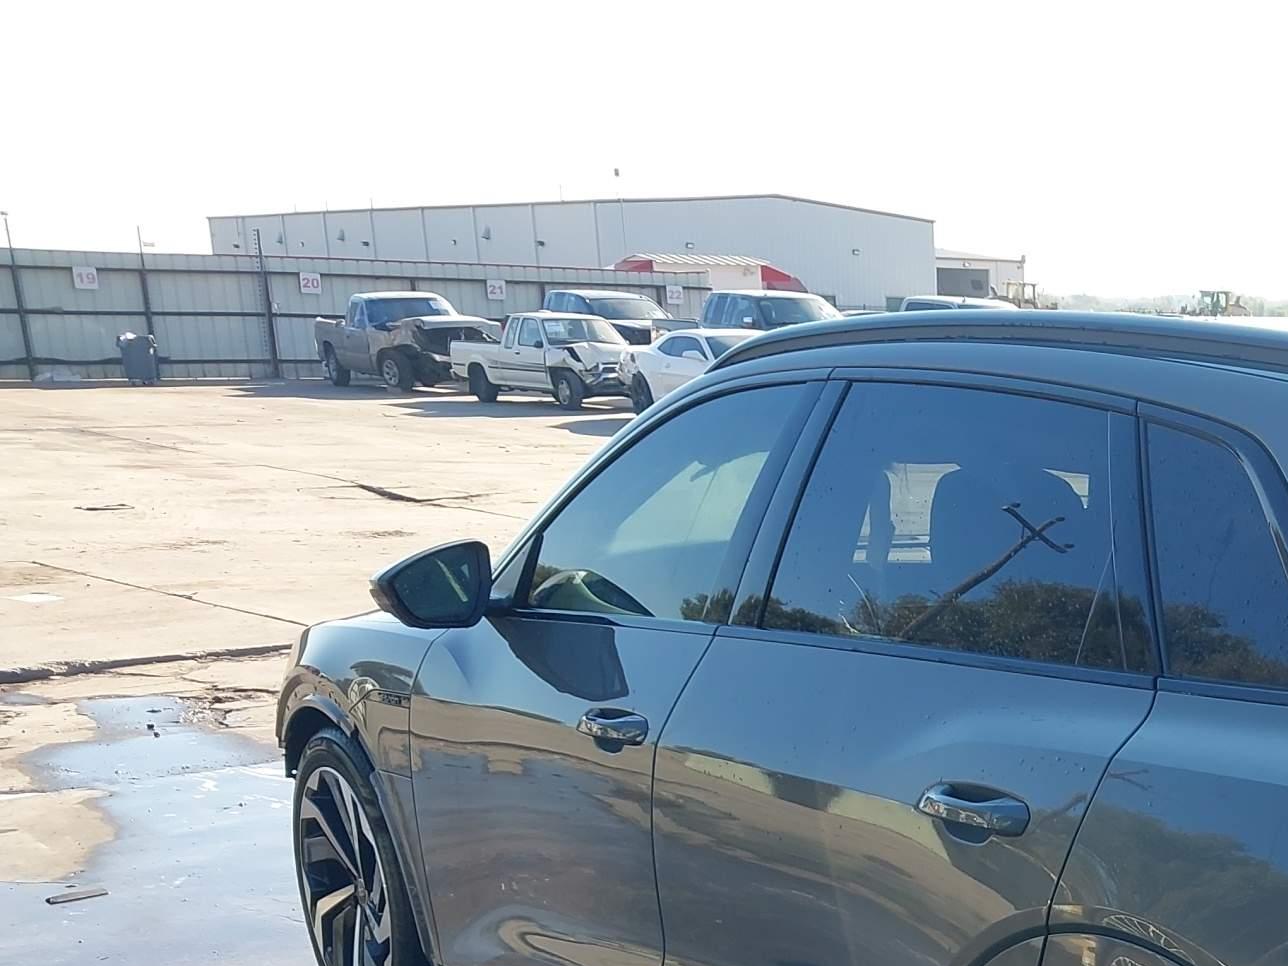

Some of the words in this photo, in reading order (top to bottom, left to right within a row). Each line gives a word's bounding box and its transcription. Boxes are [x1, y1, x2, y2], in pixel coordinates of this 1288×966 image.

[75, 271, 97, 285] 19
[302, 277, 320, 289] 20
[488, 284, 504, 296] 21
[668, 289, 683, 300] 22
